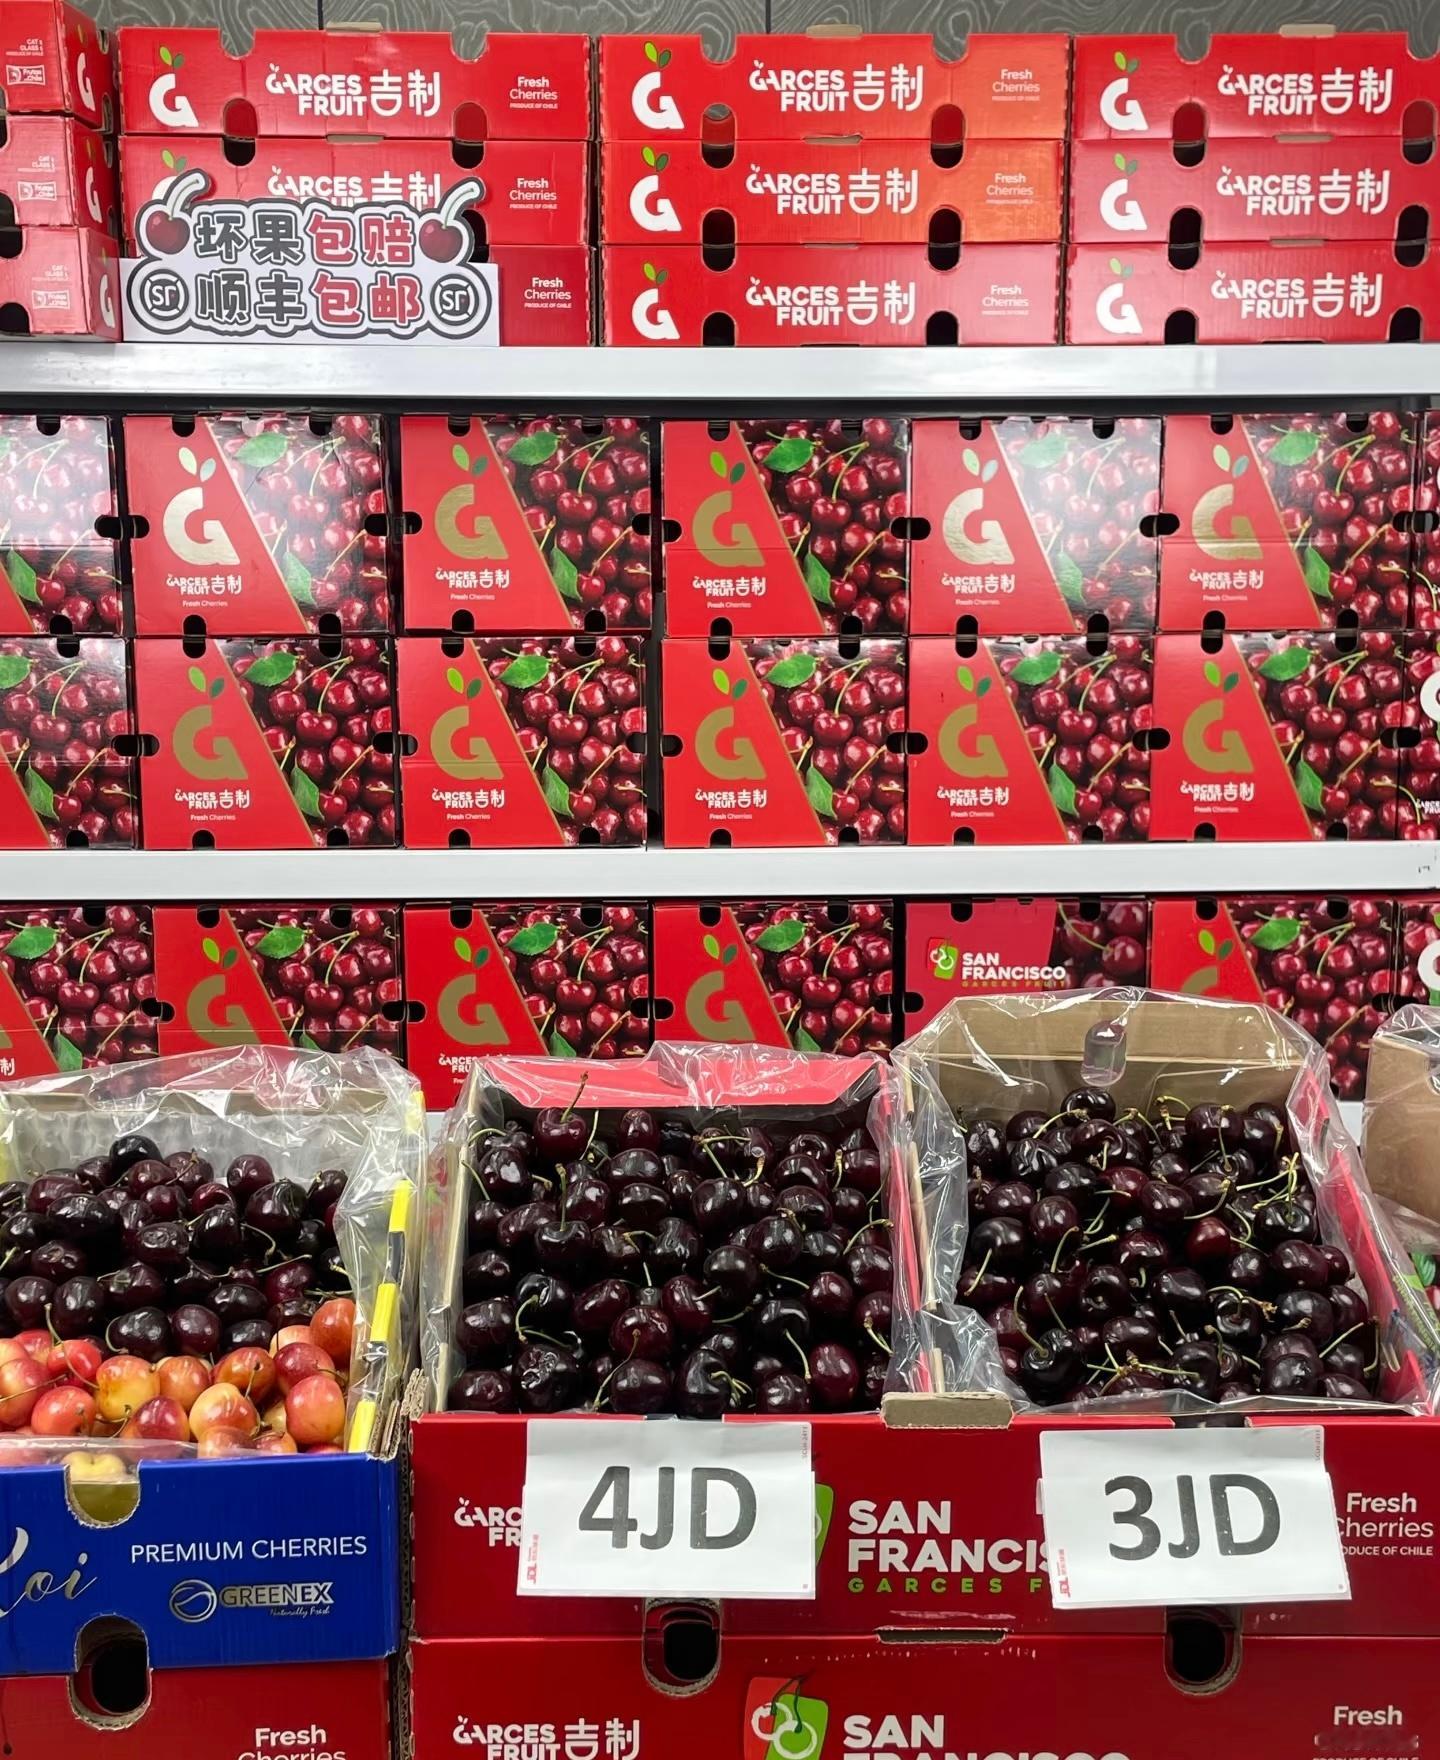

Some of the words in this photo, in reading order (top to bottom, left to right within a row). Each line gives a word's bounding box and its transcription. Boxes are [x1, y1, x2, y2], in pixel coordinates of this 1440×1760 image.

[266, 73, 363, 95] GARCES
[517, 76, 550, 87] Fresh
[748, 69, 845, 92] GARCES
[1000, 68, 1032, 80] Fresh
[1218, 73, 1313, 95] GARCES
[509, 88, 558, 100] Cherries
[992, 80, 1040, 93] Cherries
[298, 95, 367, 116] FRUIT
[780, 92, 848, 112] FRUIT
[1248, 95, 1317, 116] FRUIT
[267, 176, 363, 196] GARCES
[516, 177, 549, 188] Fresh
[746, 173, 841, 194] GARCES
[994, 172, 1026, 184] Fresh
[1216, 174, 1311, 196] GARCES
[509, 189, 557, 200] Cherries
[985, 184, 1034, 196] Cherries
[776, 194, 845, 215] FRUIT
[1246, 196, 1315, 216] FRUIT
[197, 213, 413, 263] 坏果包赔
[531, 277, 564, 288] Fresh
[990, 284, 1022, 296] Fresh
[1211, 278, 1304, 300] GARCES
[199, 270, 423, 325] 顺丰包邮
[524, 289, 572, 300] Cherries
[745, 285, 839, 307] GARCES
[982, 296, 1029, 308] Cherries
[776, 306, 844, 326] FRUIT
[1241, 299, 1309, 319] FRUIT
[180, 586, 210, 595] FRUIT
[449, 579, 479, 588] FRUIT
[705, 588, 735, 597] FRUIT
[954, 585, 984, 594] FRUIT
[1202, 580, 1232, 590] FRUIT
[188, 800, 218, 809] FRUIT
[445, 800, 474, 808] FRUIT
[708, 800, 737, 808] FRUIT
[950, 798, 978, 806] FRUIT
[962, 953, 1000, 966] SAN
[962, 966, 1066, 980] FRANCISCO
[578, 1465, 758, 1549] 4JD
[1346, 1492, 1417, 1513] Fresh
[848, 1500, 951, 1534] SAN
[1104, 1473, 1281, 1561] 3JD
[131, 1540, 243, 1564] PREMIUM
[251, 1535, 367, 1559] CHERRIES
[1382, 1546, 1398, 1556] OF
[1400, 1546, 1434, 1556] CHILE
[221, 1582, 334, 1607] GREENEX
[848, 1577, 1003, 1593] GARCES
[1333, 1704, 1403, 1726] Fresh
[255, 1724, 327, 1748] Fresh
[453, 1724, 556, 1744] GARCES
[843, 1714, 945, 1749] SAN
